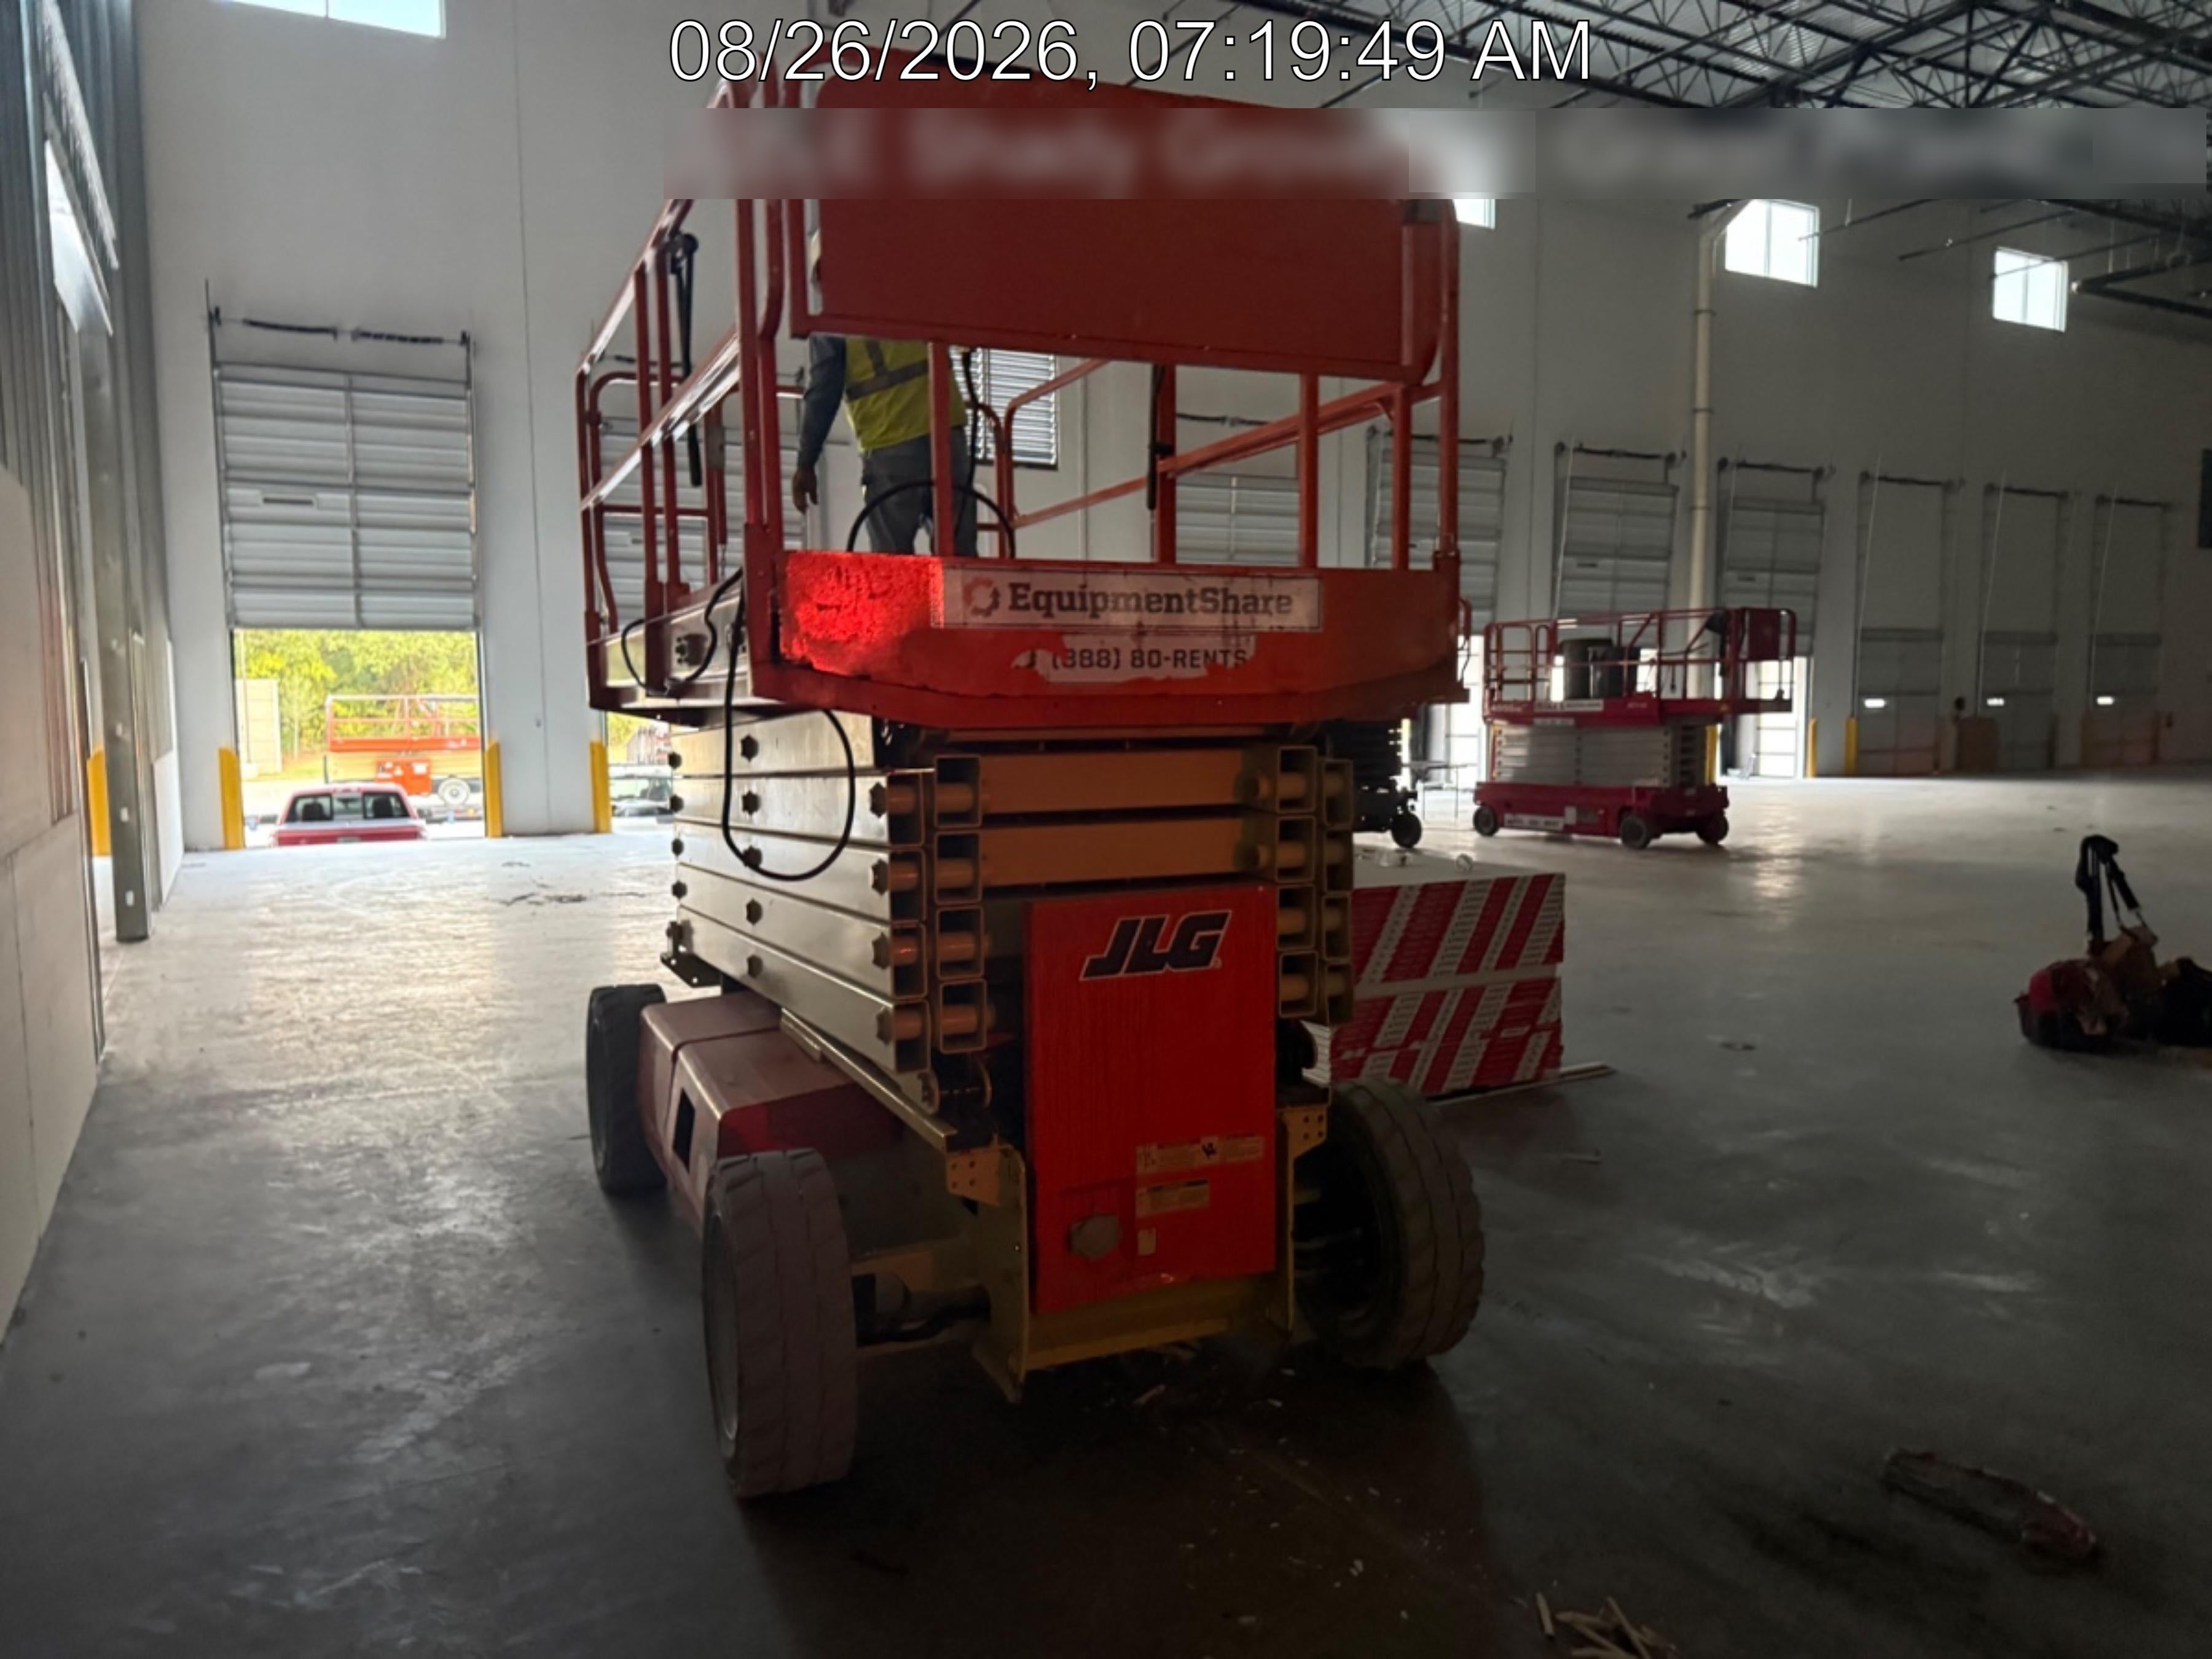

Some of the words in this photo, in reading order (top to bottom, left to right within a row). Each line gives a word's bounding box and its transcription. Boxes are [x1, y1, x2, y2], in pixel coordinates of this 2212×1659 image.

[1008, 582, 1293, 618] EquipmentShare
[1131, 648, 1247, 669] 80-RENTS
[1080, 909, 1231, 981] JLG
